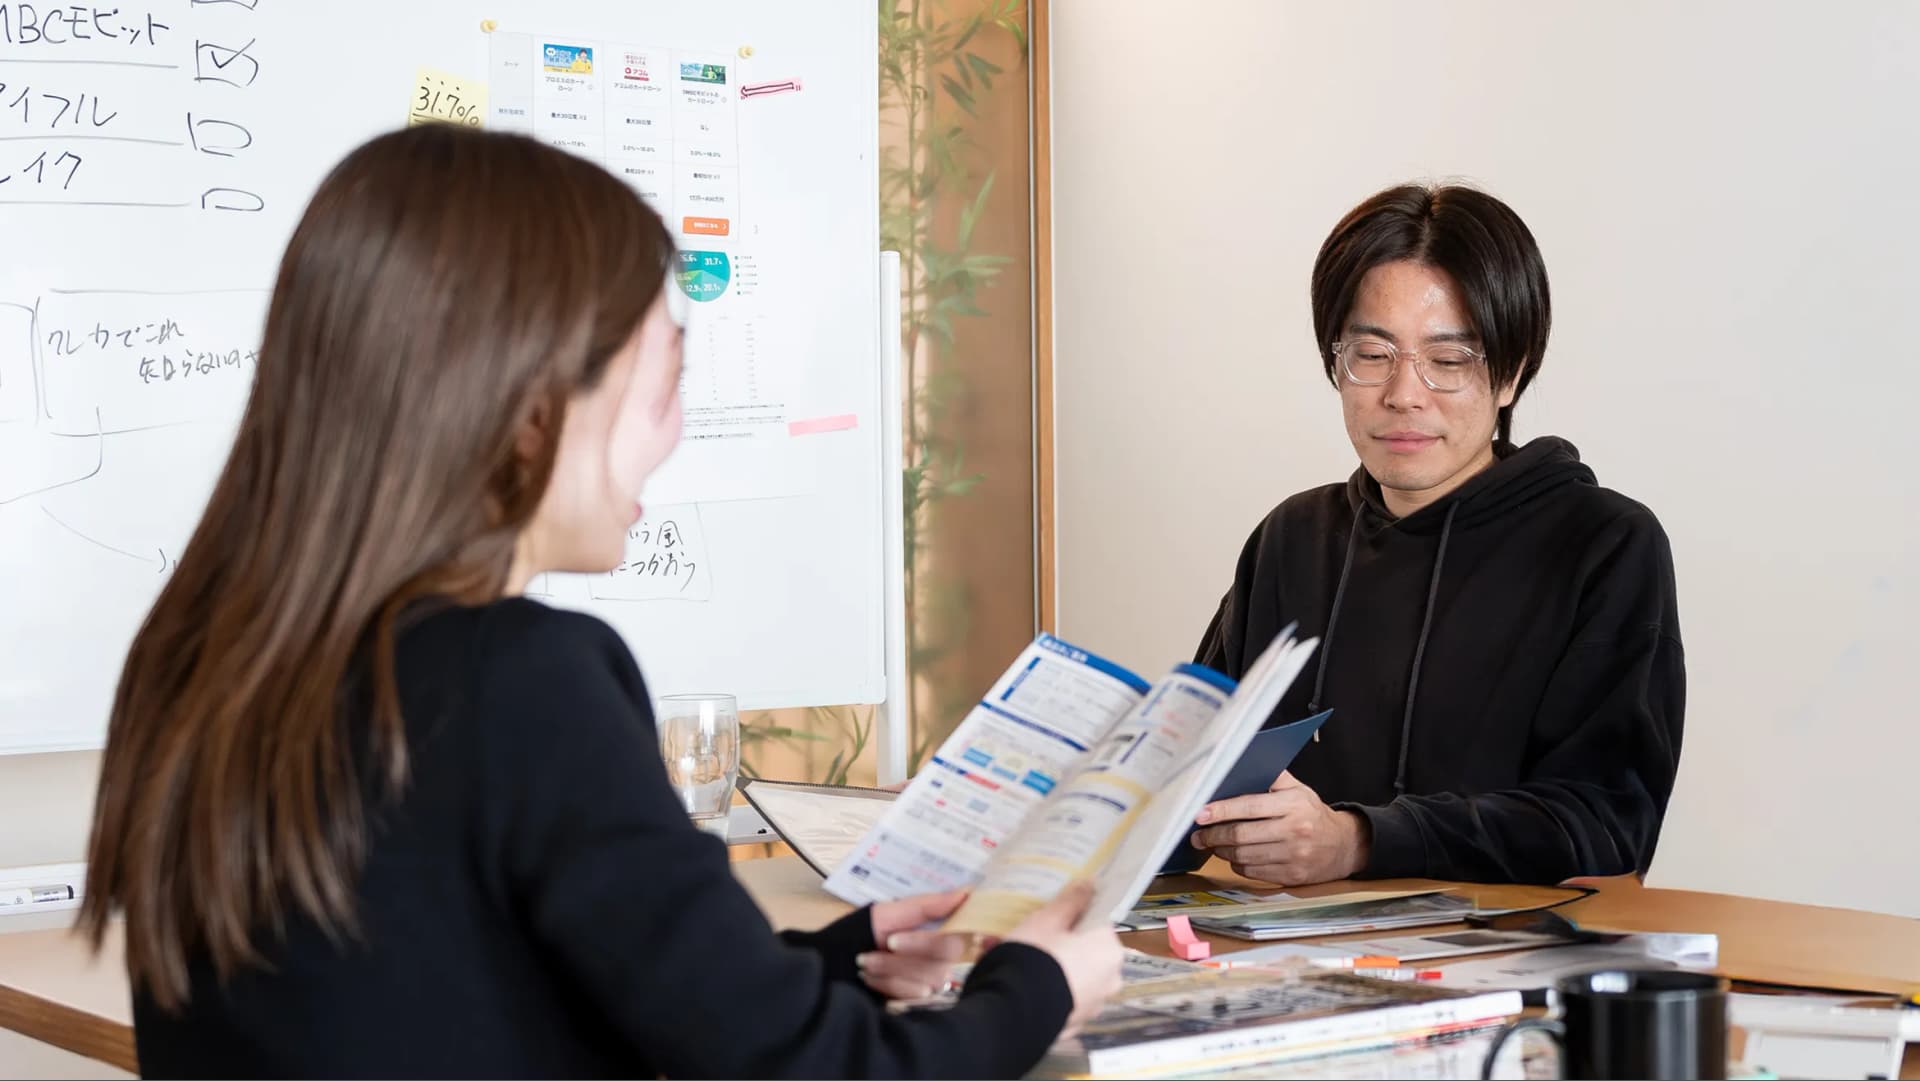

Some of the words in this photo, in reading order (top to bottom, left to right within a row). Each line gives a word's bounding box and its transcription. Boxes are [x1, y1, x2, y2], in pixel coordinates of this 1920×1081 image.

[415, 86, 480, 126] 31.7%
[614, 82, 662, 92] アコムのカードローン
[0, 151, 82, 189] イク
